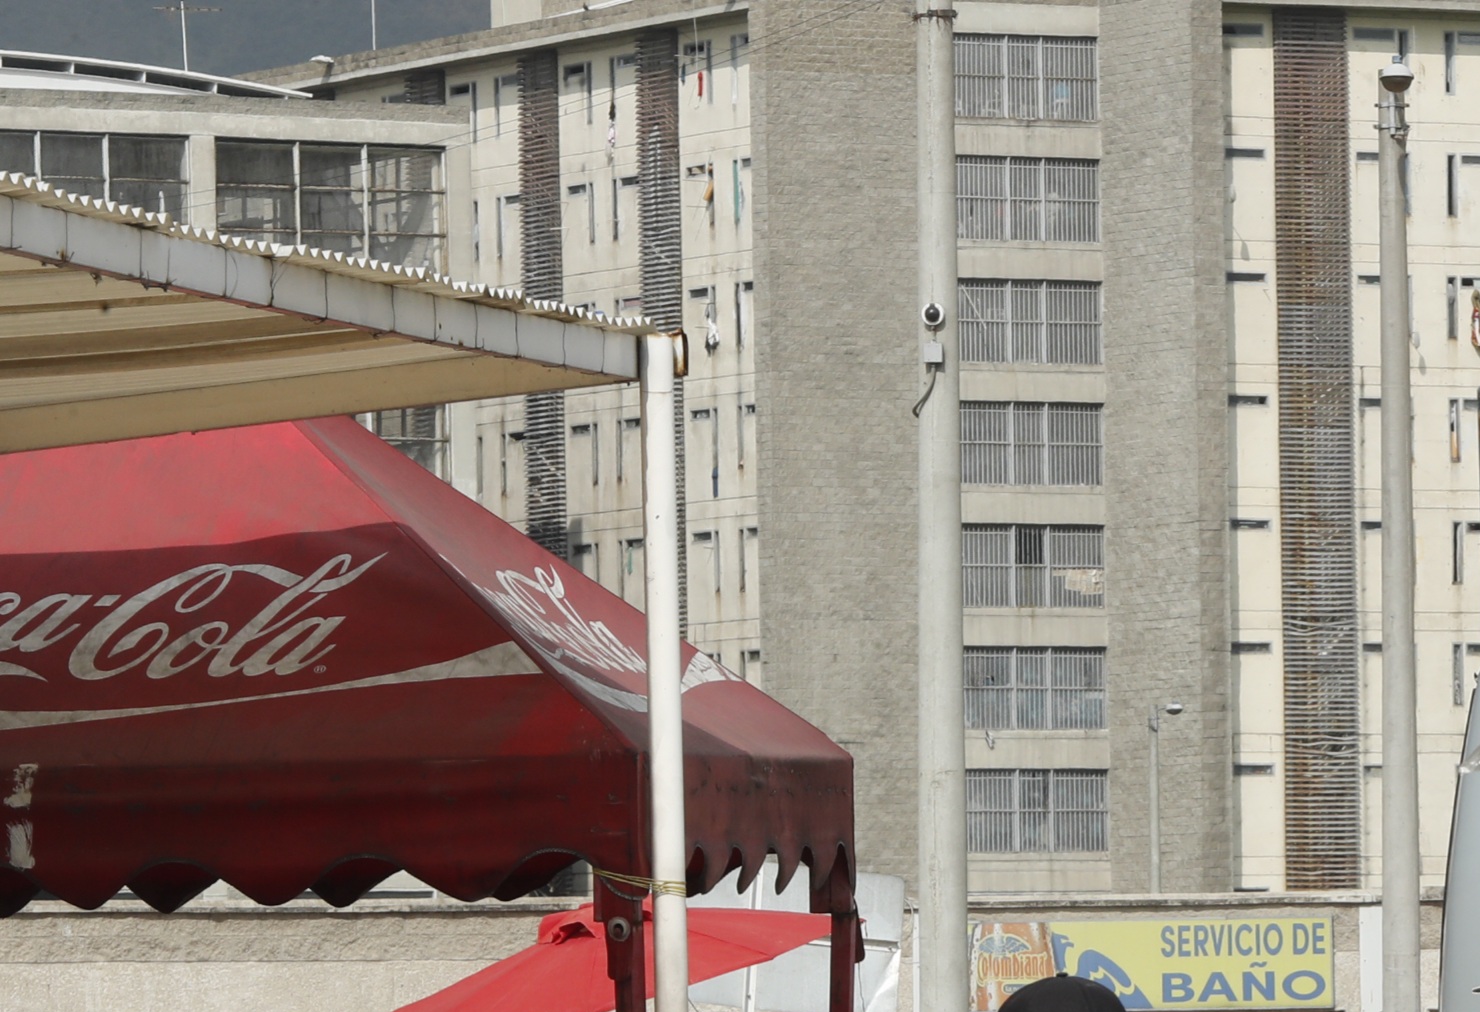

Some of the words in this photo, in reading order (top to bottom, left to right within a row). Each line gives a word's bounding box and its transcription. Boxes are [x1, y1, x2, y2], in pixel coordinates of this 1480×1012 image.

[1161, 923, 1283, 958] SERVICIO
[1292, 922, 1326, 955] DE
[1161, 961, 1326, 1003] BAÑO
